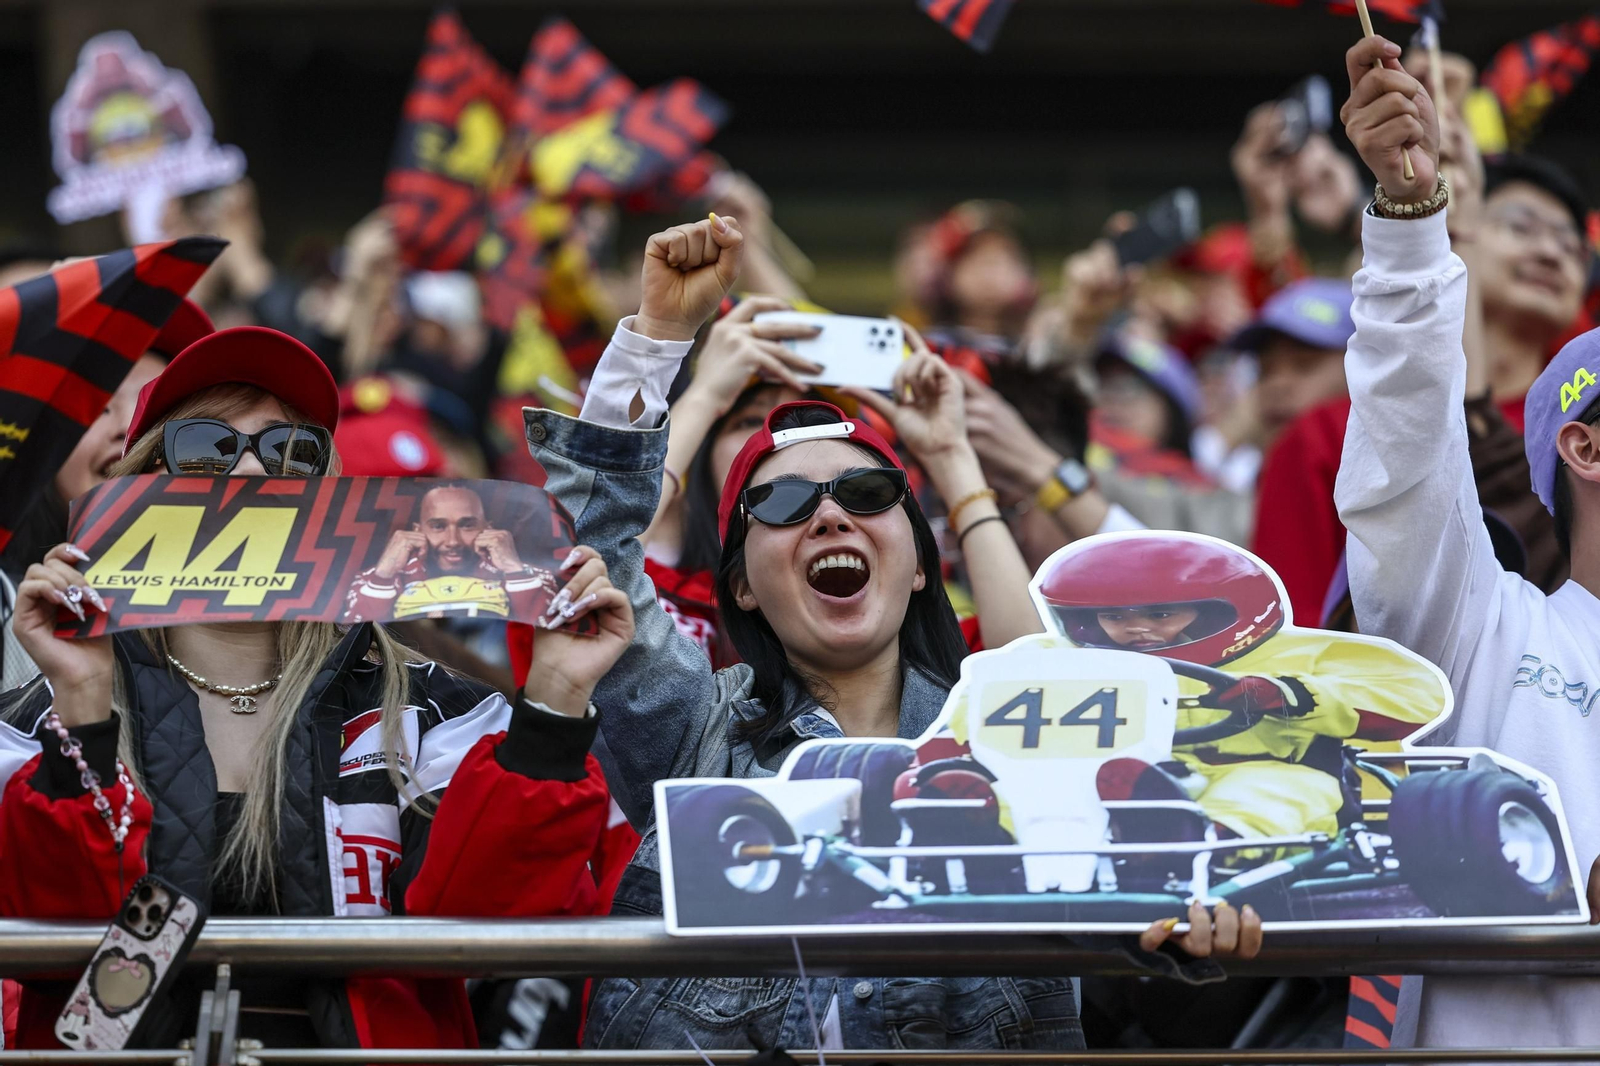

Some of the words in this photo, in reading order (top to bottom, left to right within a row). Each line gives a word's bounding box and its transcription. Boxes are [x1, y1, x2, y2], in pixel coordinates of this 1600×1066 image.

[1560, 367, 1597, 413] 44
[84, 504, 299, 606] 44
[92, 574, 164, 587] LEWIS
[169, 575, 287, 588] HAMILTON
[984, 687, 1127, 749] 44
